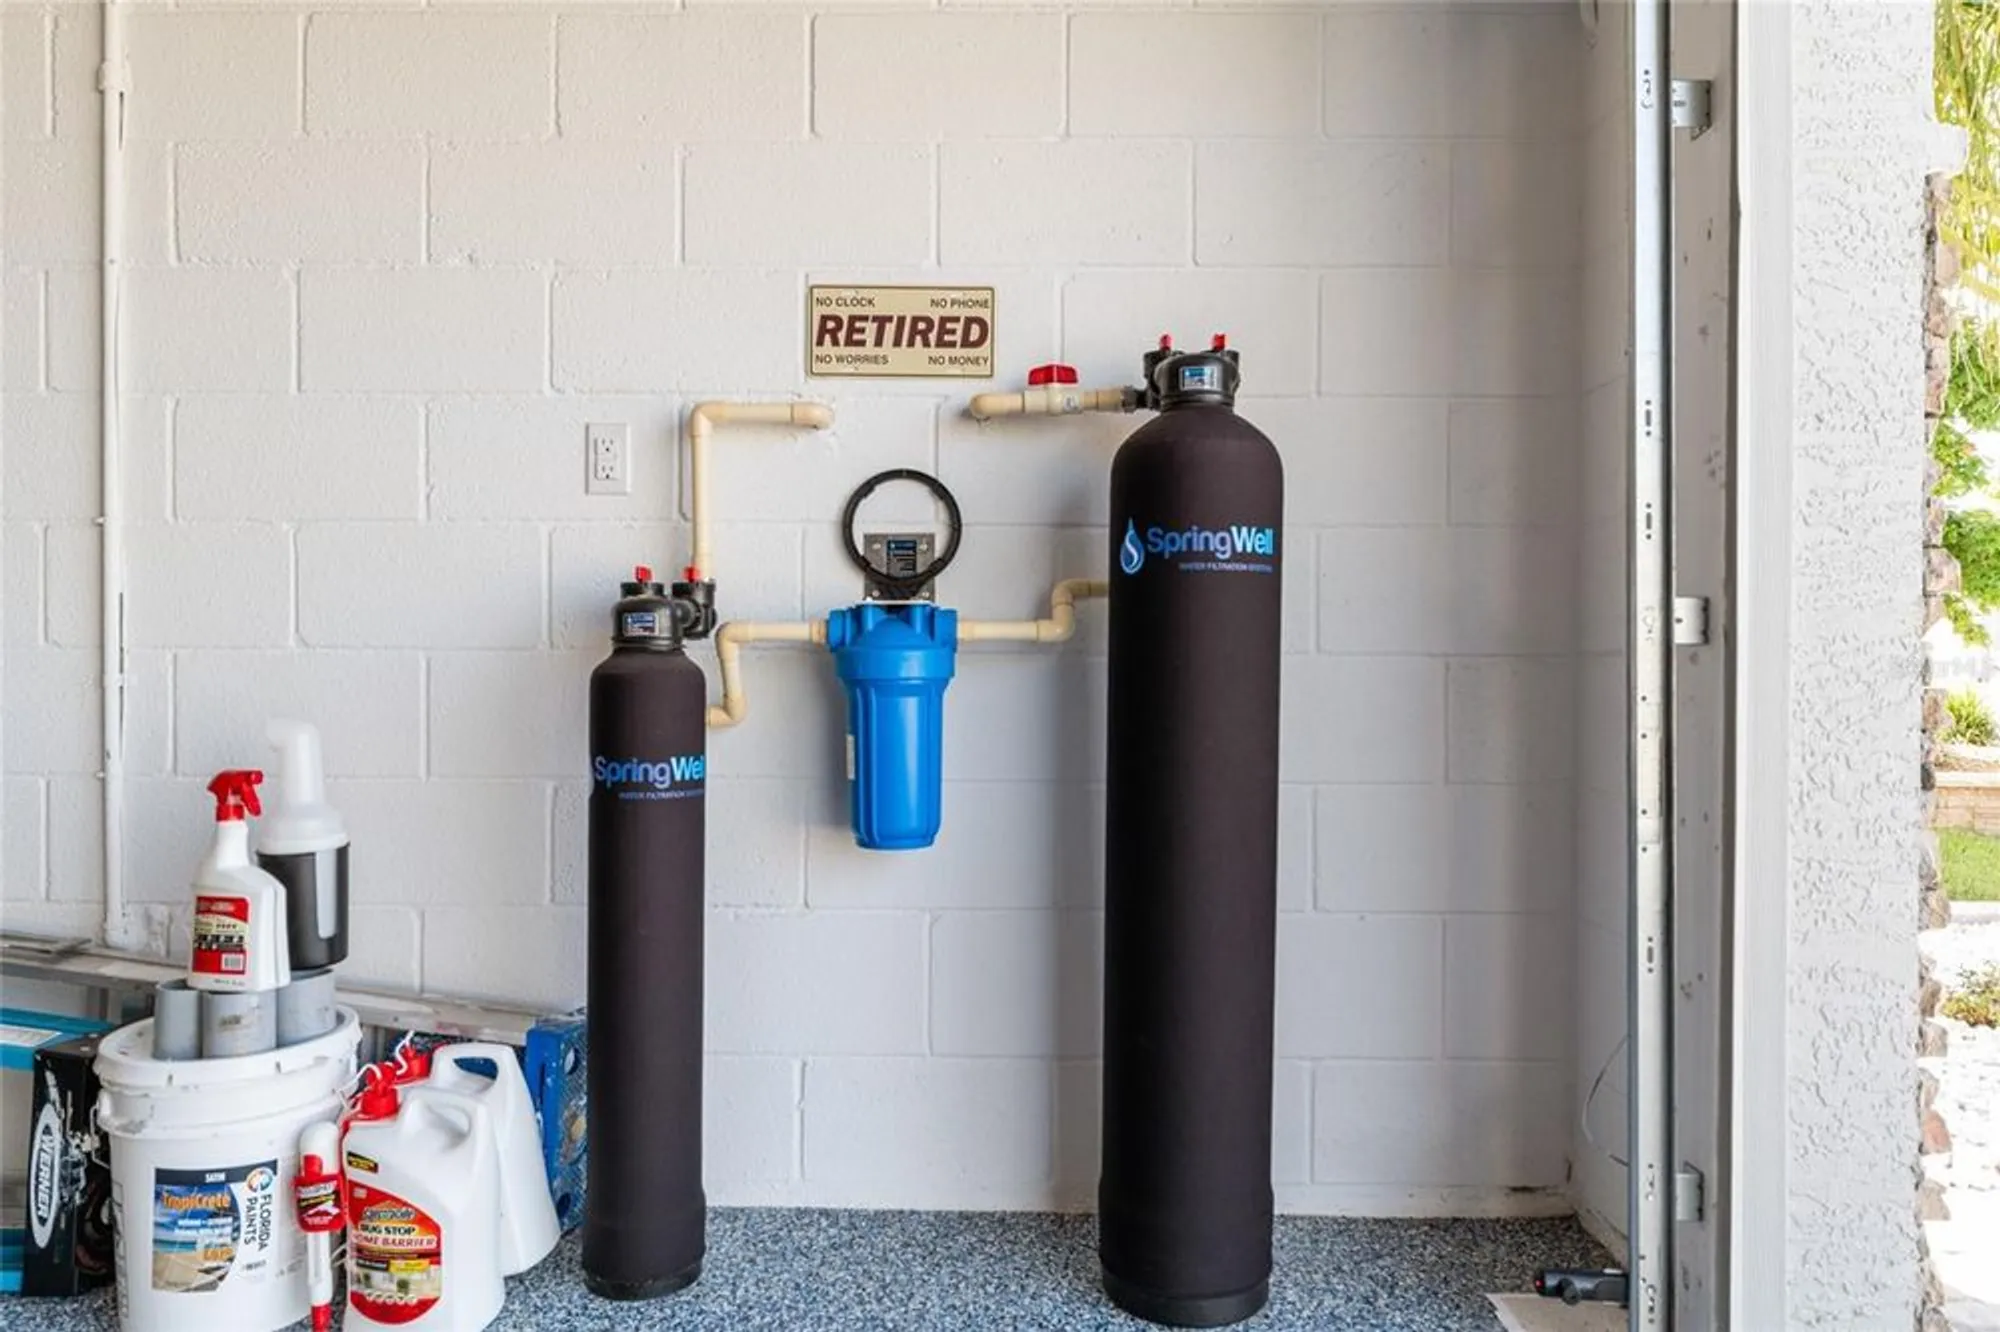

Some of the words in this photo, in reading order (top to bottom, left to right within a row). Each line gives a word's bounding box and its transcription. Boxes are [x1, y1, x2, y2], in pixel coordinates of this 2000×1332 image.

[815, 297, 833, 308] NO
[835, 297, 876, 308] CLOCK
[930, 298, 947, 308] NO
[949, 298, 990, 309] PHONE
[815, 314, 989, 349] RETIRED
[815, 354, 832, 365] NO
[835, 354, 889, 365] WORRIES
[928, 355, 946, 365] NO
[948, 356, 990, 366] MONEY
[1147, 525, 1274, 560] SpringWell
[594, 755, 706, 789] SpringWel
[37, 1135, 54, 1219] WERNER
[243, 1195, 259, 1246] PAINTS
[258, 1193, 273, 1252] FLORIDA
[384, 1225, 417, 1236] STOP
[381, 1236, 436, 1249] BARRIER
